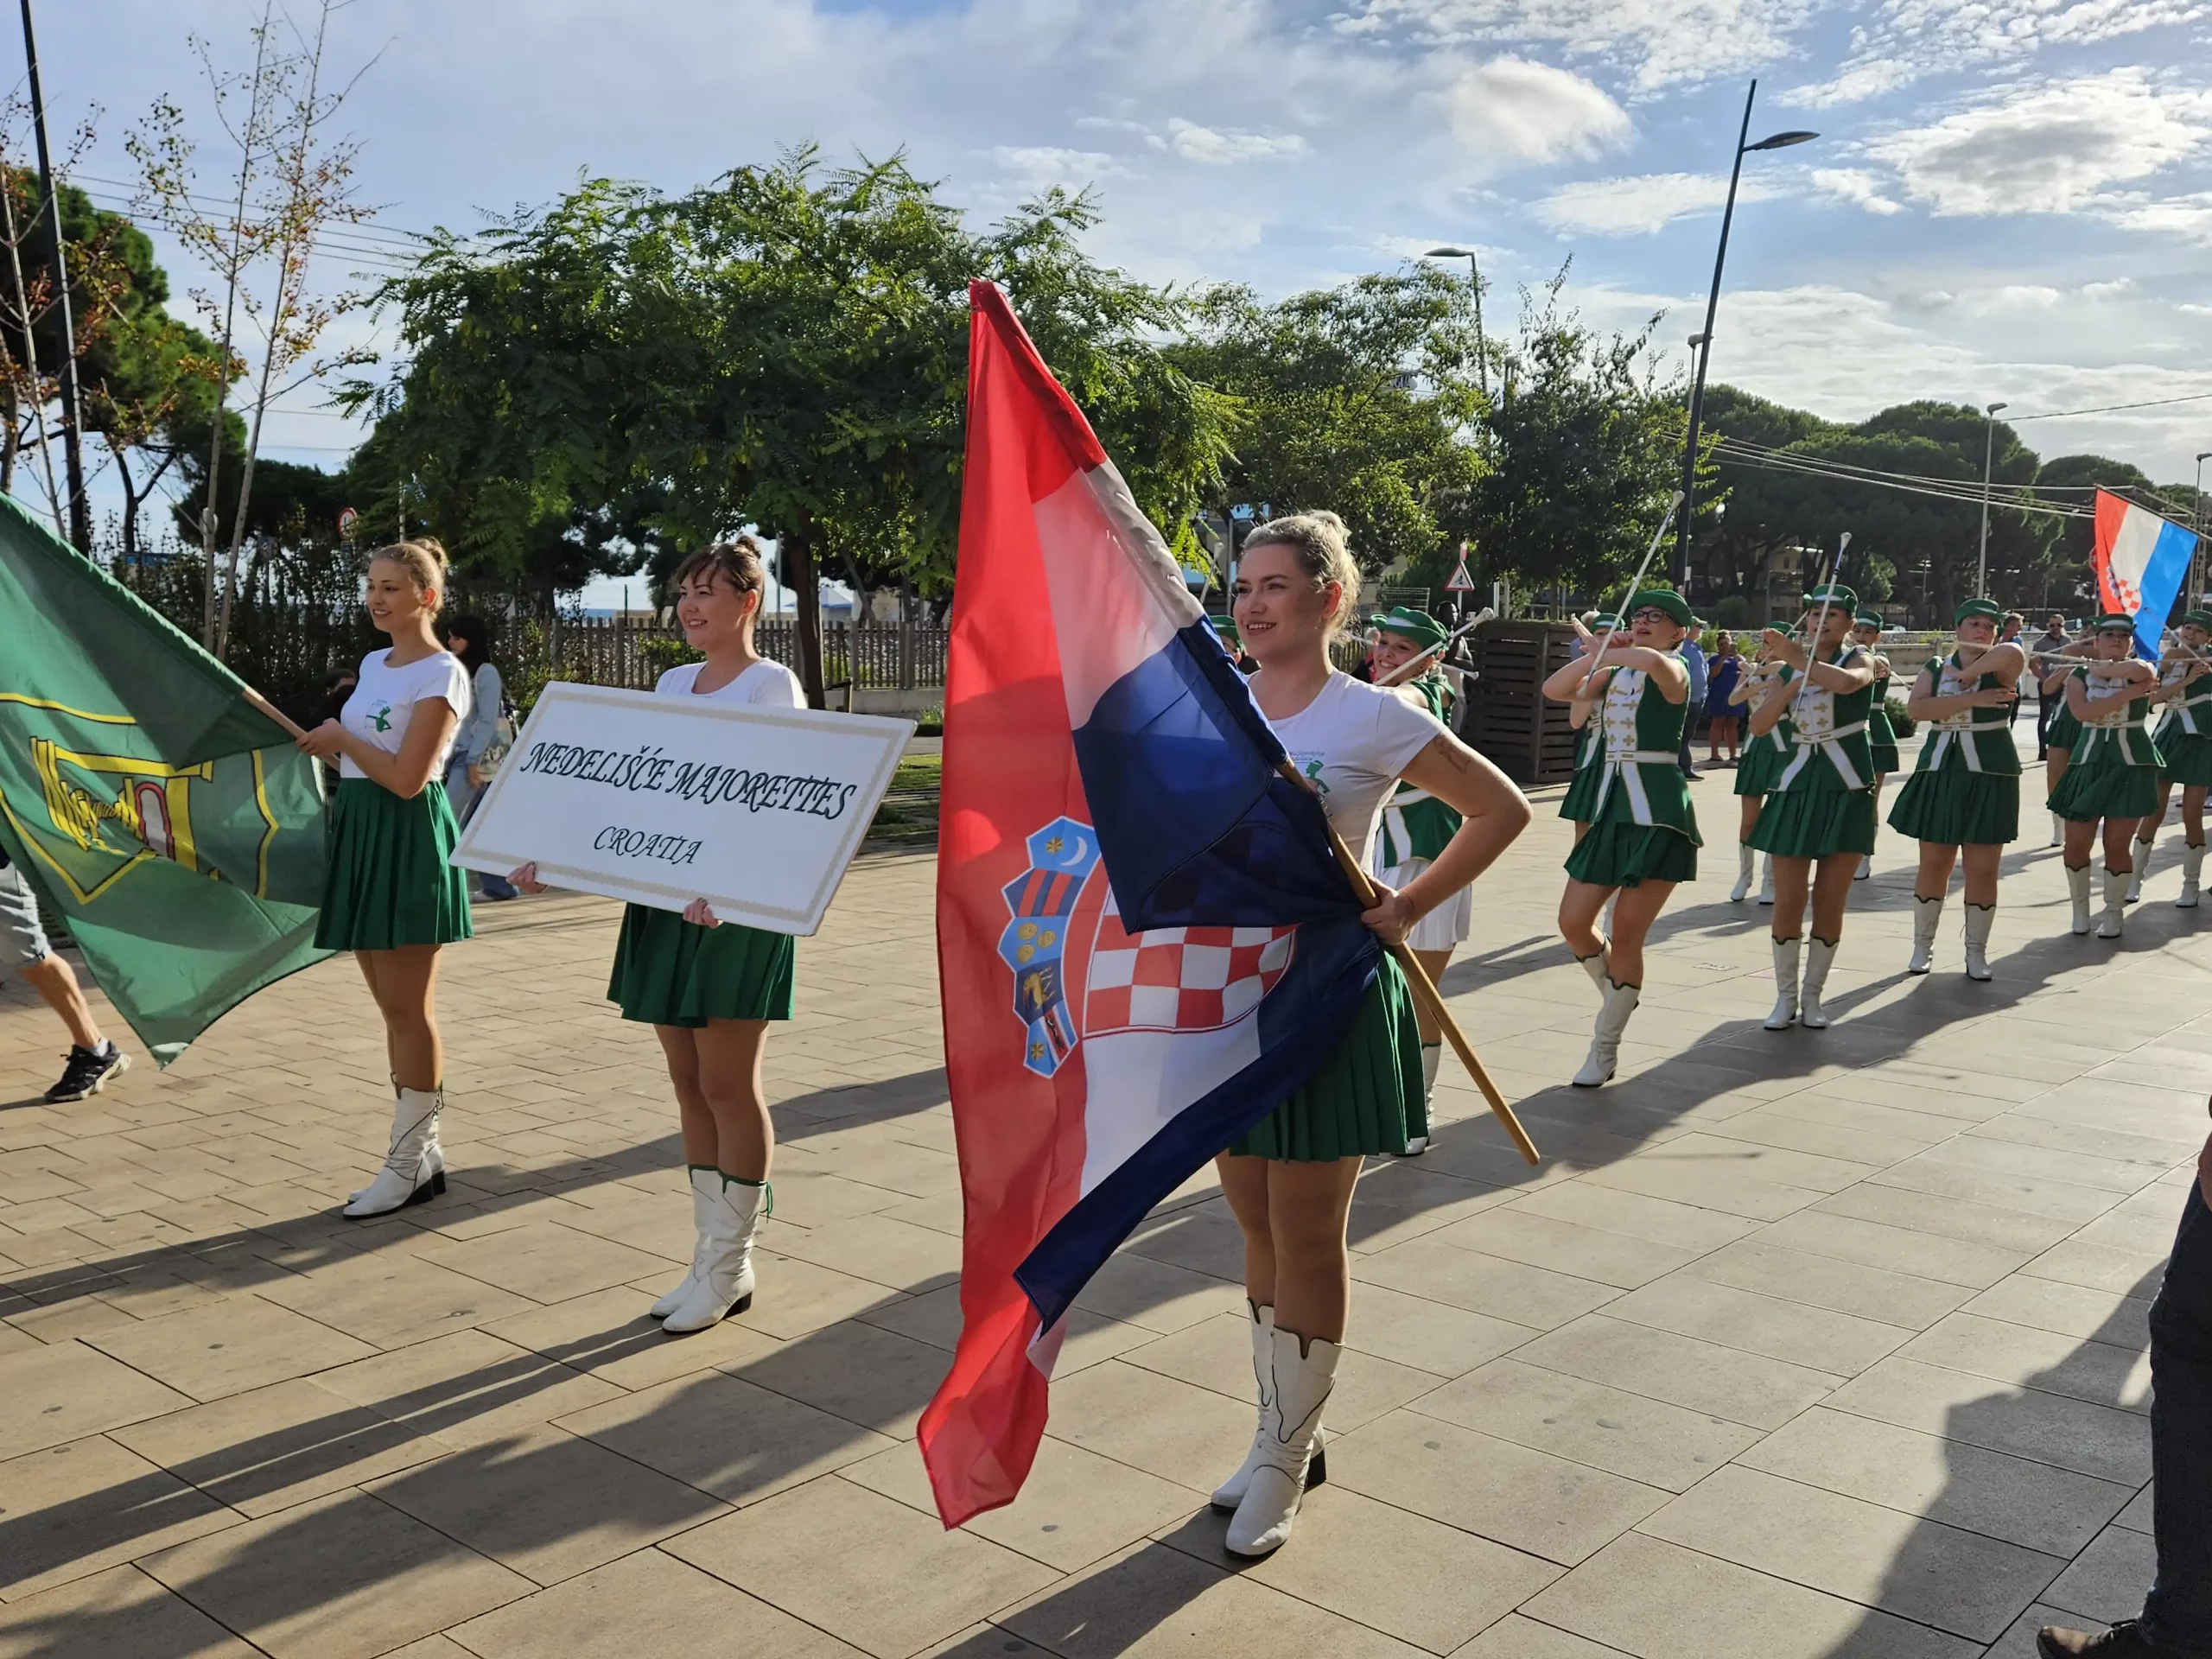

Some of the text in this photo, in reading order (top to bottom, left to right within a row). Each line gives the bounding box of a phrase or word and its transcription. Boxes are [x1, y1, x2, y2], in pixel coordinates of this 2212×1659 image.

[519, 741, 858, 820] NEDELIŠĆE MAJORETTES
[594, 826, 703, 865] CROATIA
